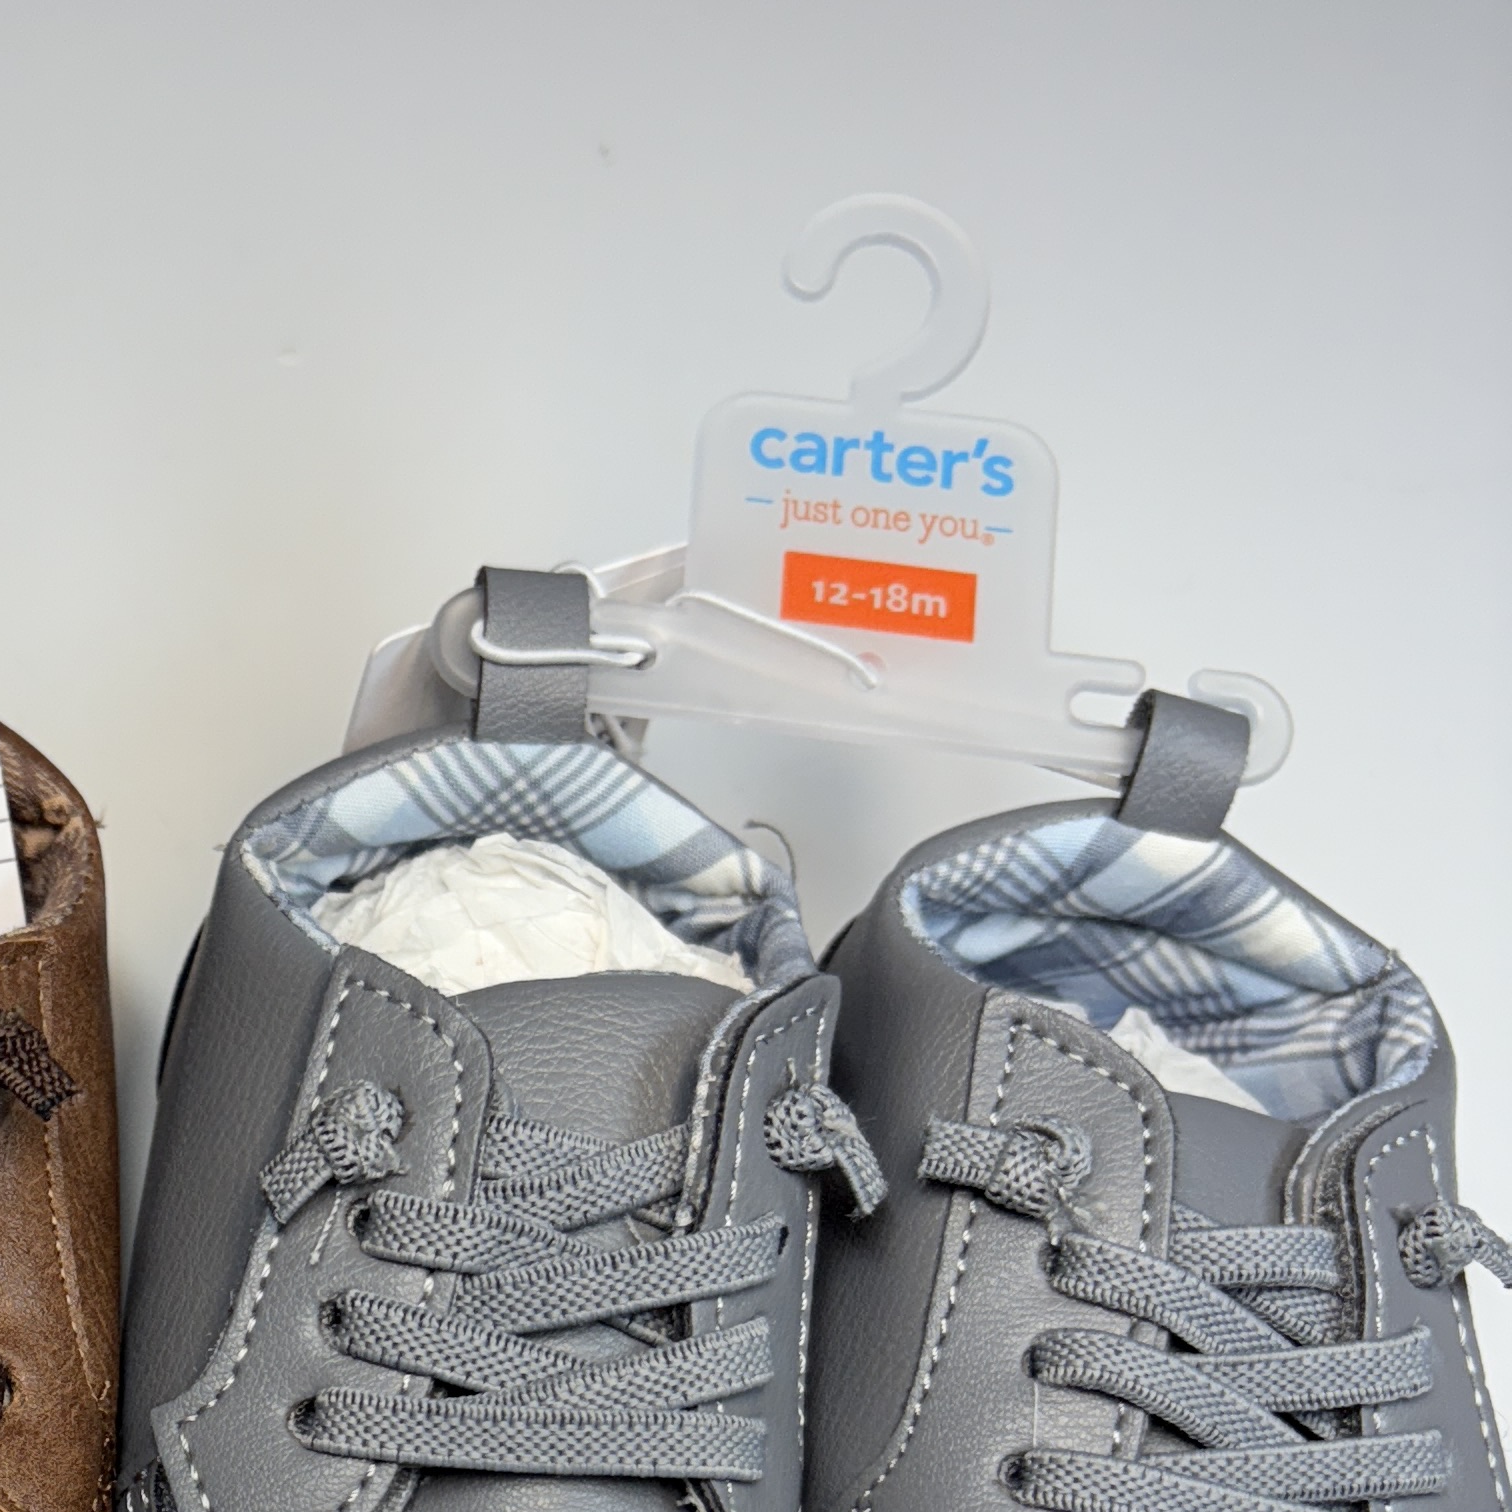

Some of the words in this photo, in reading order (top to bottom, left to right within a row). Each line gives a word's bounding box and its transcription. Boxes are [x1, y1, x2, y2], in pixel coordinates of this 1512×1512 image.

[749, 427, 1015, 497] carter's
[779, 489, 842, 529] just
[850, 505, 912, 532] one
[811, 579, 948, 619] 12-18m
